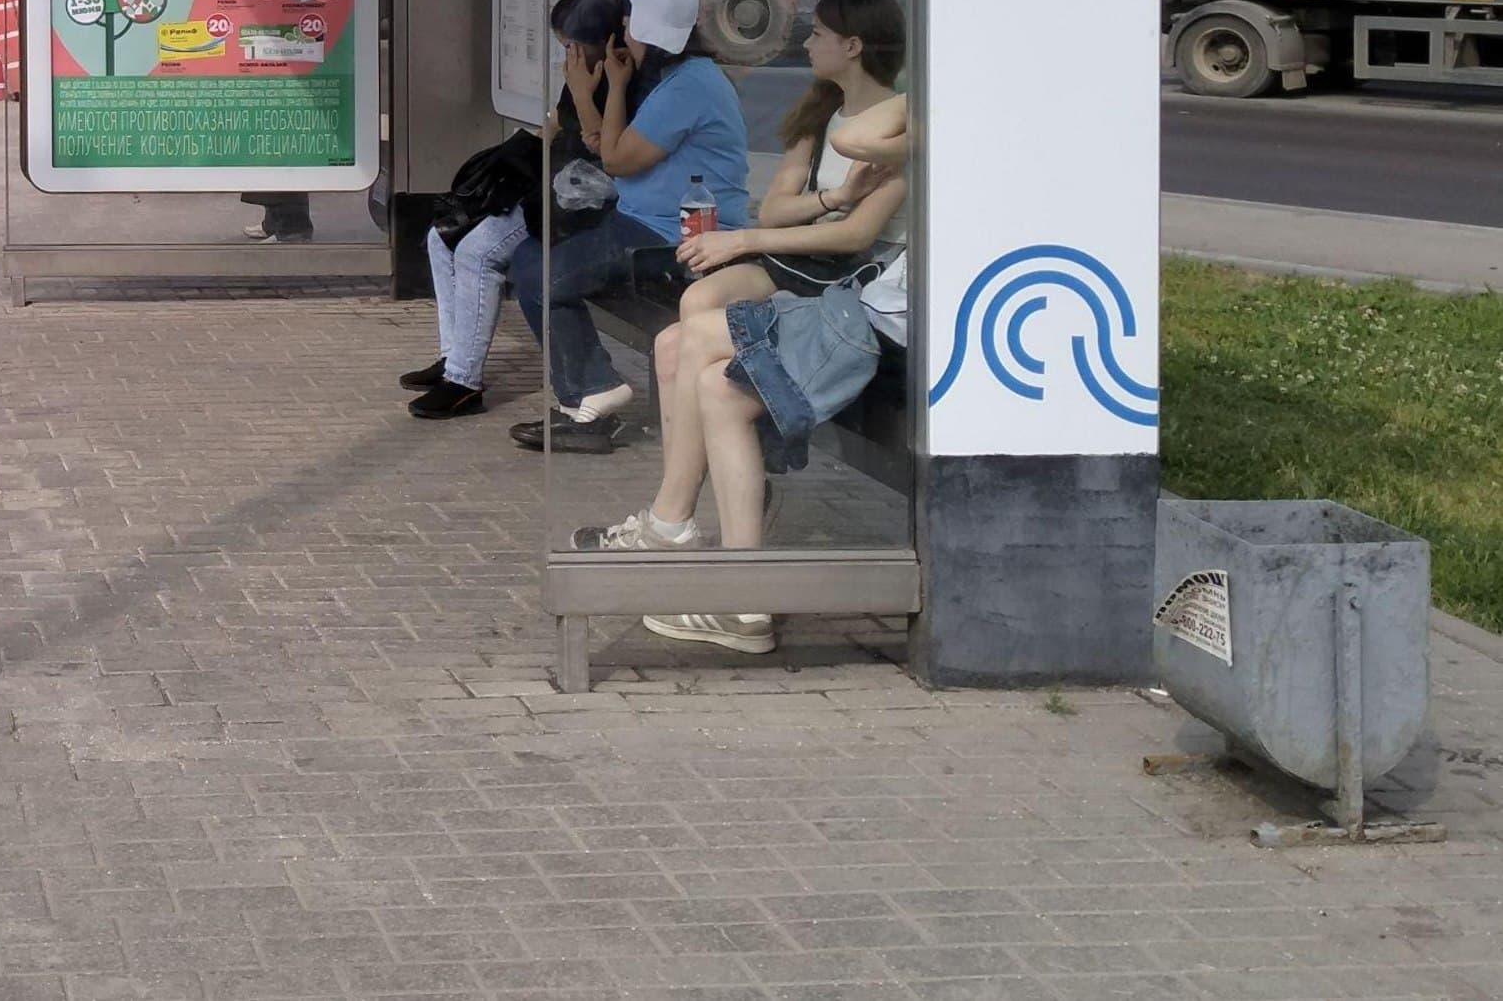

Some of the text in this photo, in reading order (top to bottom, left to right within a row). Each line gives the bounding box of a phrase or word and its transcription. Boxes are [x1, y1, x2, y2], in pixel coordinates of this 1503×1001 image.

[58, 110, 118, 131] ИМЕЮТСЯ
[255, 109, 339, 132] НЕОБХОДИМО
[58, 133, 339, 157] ПОЛУЧЕНИЕ КОНСУЛЬТАЦИИ СПЕЦИАЛИСТА
